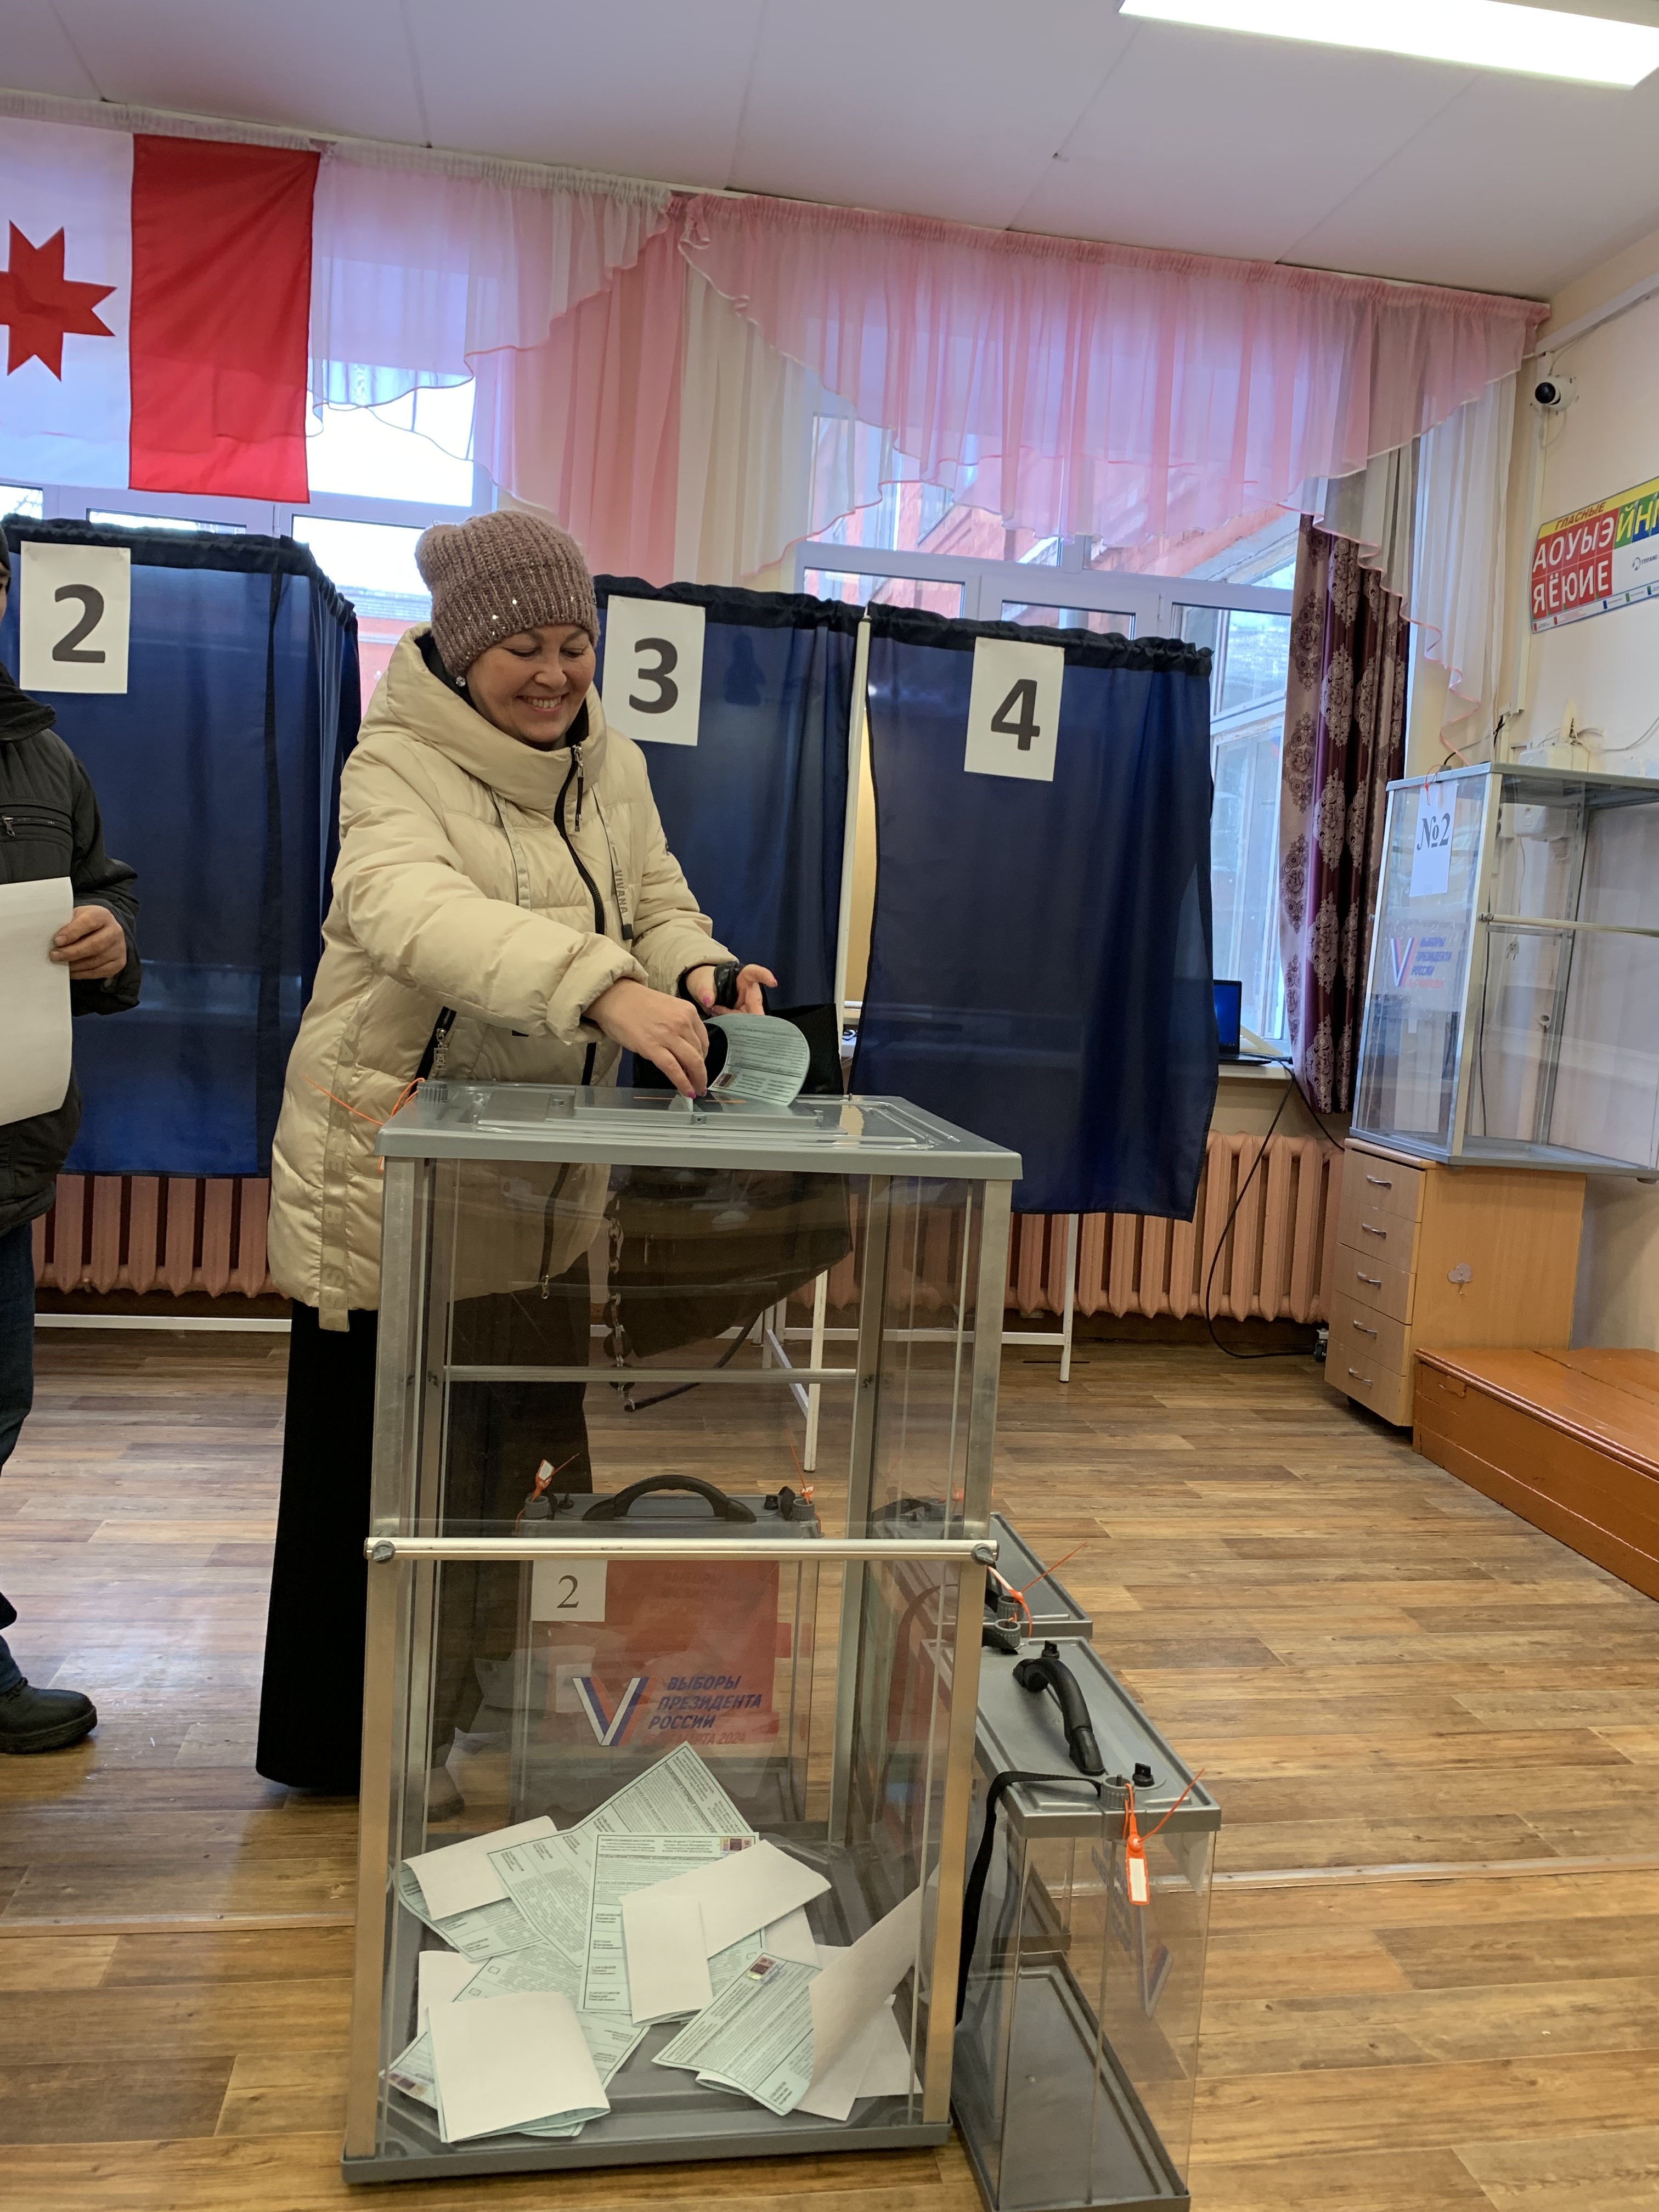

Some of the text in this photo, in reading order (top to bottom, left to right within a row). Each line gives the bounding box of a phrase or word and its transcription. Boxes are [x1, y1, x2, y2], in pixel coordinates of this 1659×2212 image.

[1555, 501, 1606, 531] ГЛАСНЫЕ
[52, 584, 106, 663] 2
[628, 637, 678, 714] 3
[990, 679, 1041, 751] 4
[1417, 812, 1451, 851] №2
[614, 868, 629, 915] VIVANA
[556, 1575, 579, 1609] 2
[667, 1675, 742, 1691] ВЫБОРЫ
[657, 1694, 762, 1711] ПРЕЗИДЕНТА
[648, 1714, 716, 1730] РОССИИ
[716, 1732, 746, 1745] 2024
